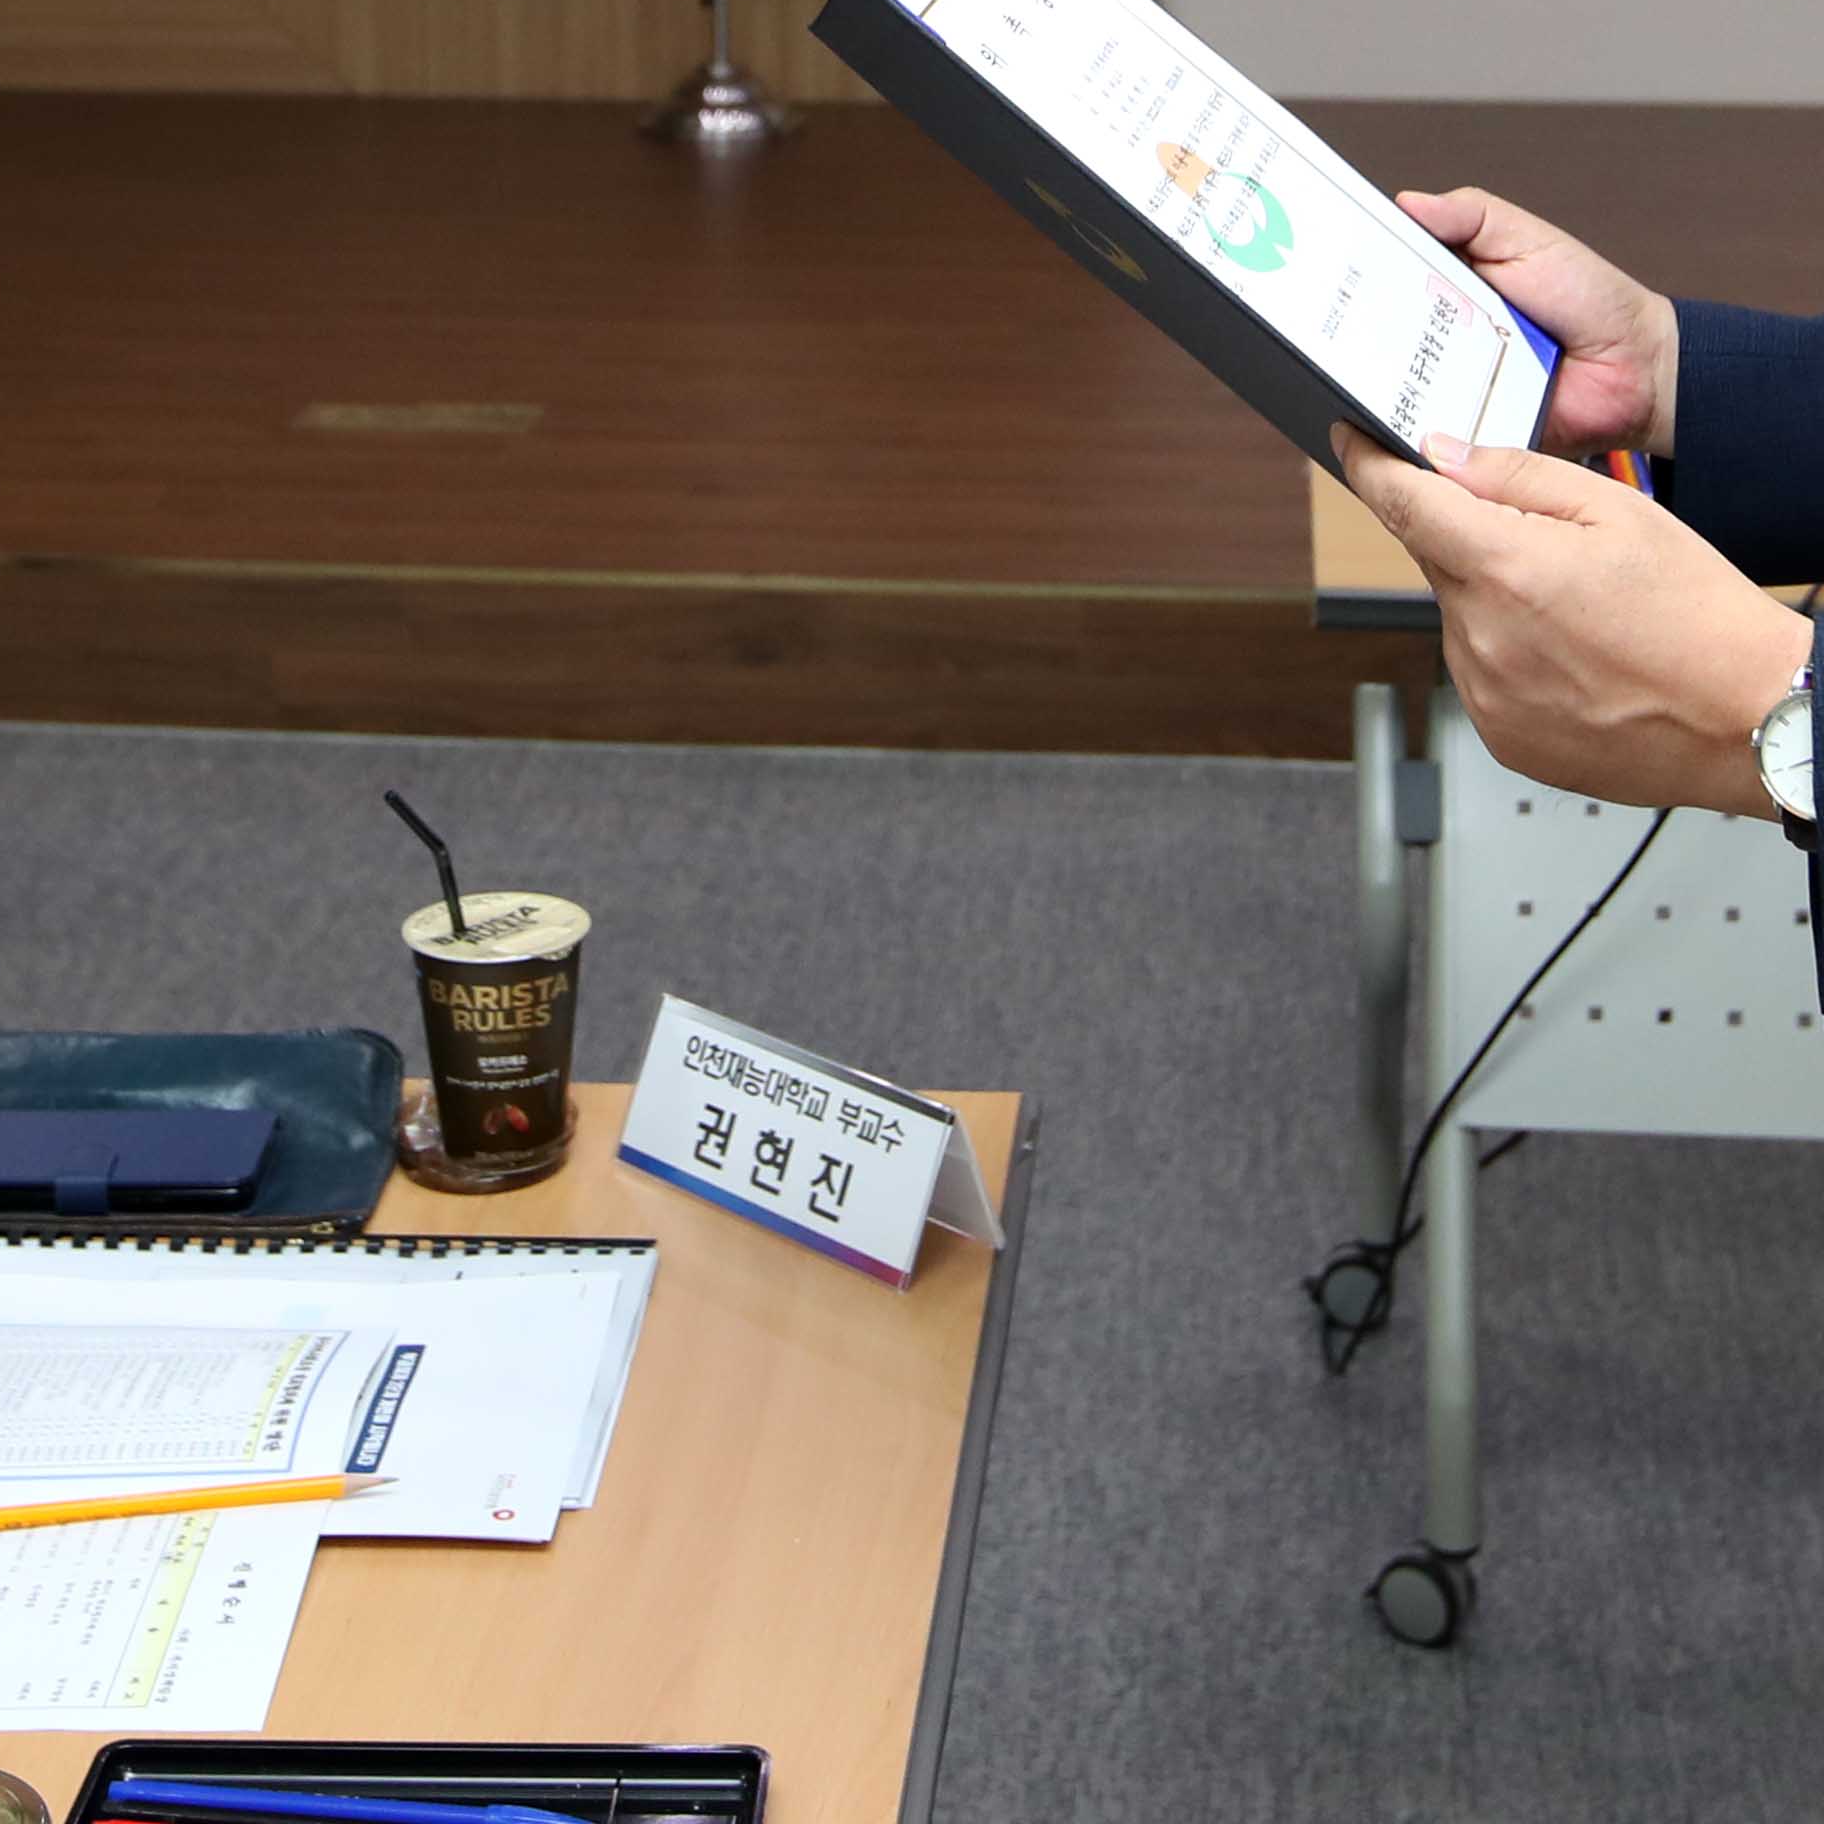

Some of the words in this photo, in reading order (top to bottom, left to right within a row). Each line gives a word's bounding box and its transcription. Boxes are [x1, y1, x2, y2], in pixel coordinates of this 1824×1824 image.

[429, 972, 570, 1005] BARISTA
[452, 1003, 553, 1033] RULES
[683, 1035, 831, 1122] 인천재능대학교
[837, 1098, 905, 1154] 부교수
